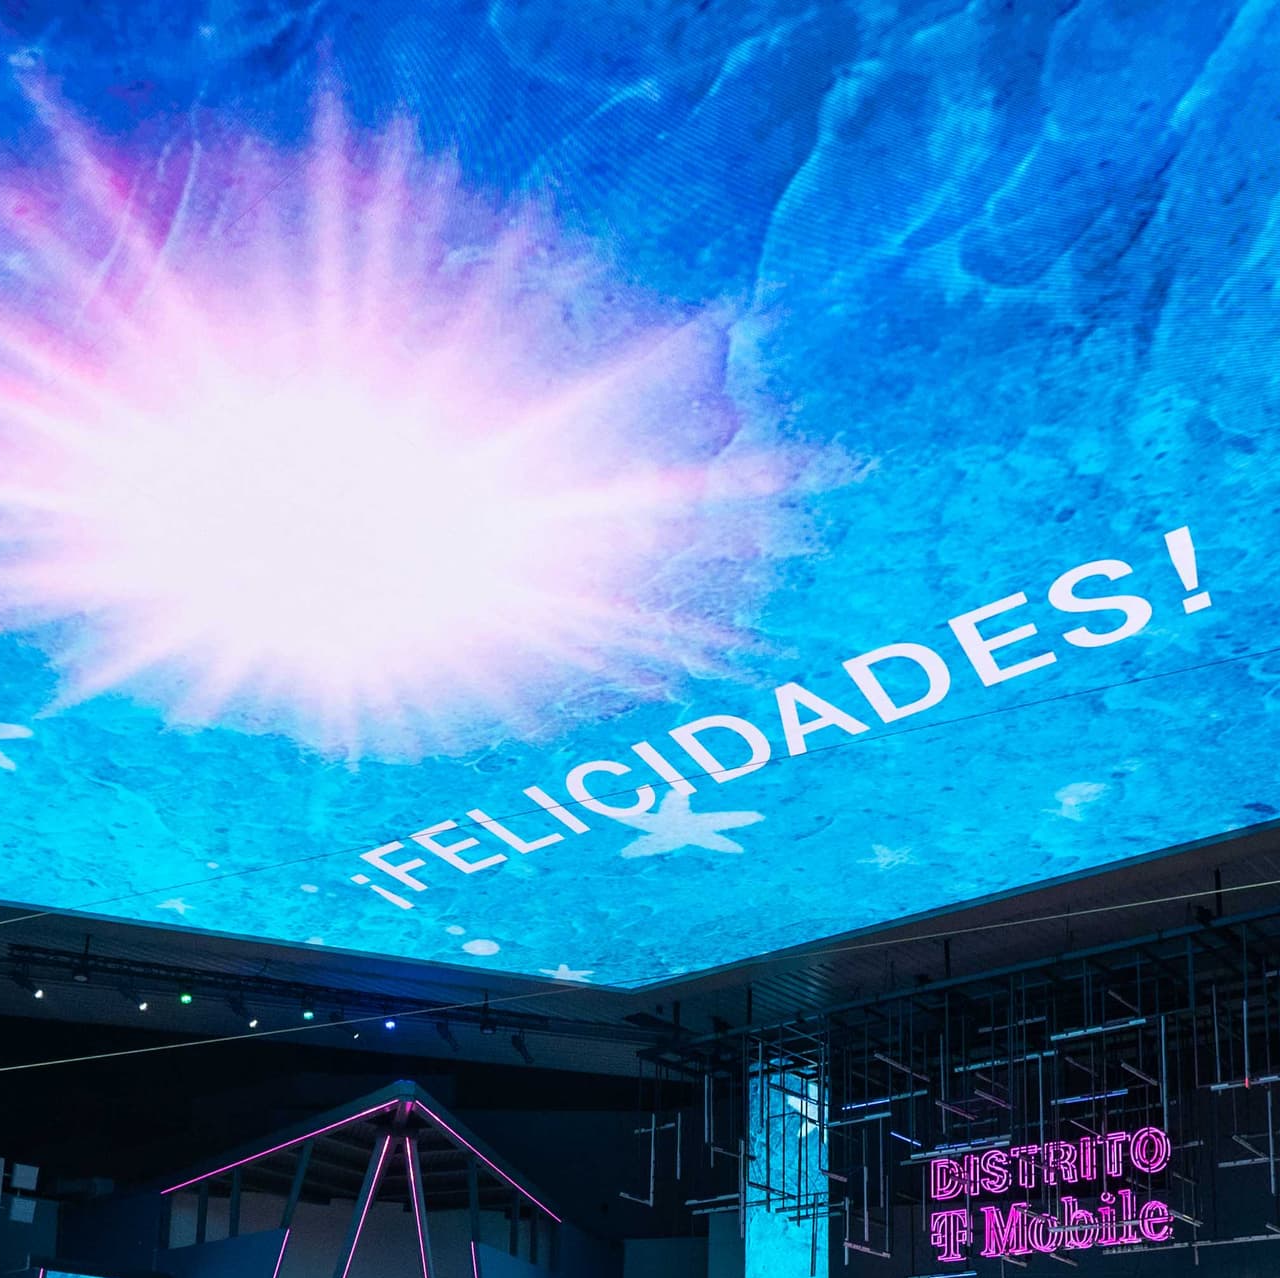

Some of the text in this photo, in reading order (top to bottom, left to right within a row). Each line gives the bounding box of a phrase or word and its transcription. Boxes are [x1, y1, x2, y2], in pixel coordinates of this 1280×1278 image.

[350, 526, 1212, 909] ¡FELICIDADES!
[930, 1126, 1172, 1201] DISTRITO
[980, 1188, 1175, 1259] Mobile
